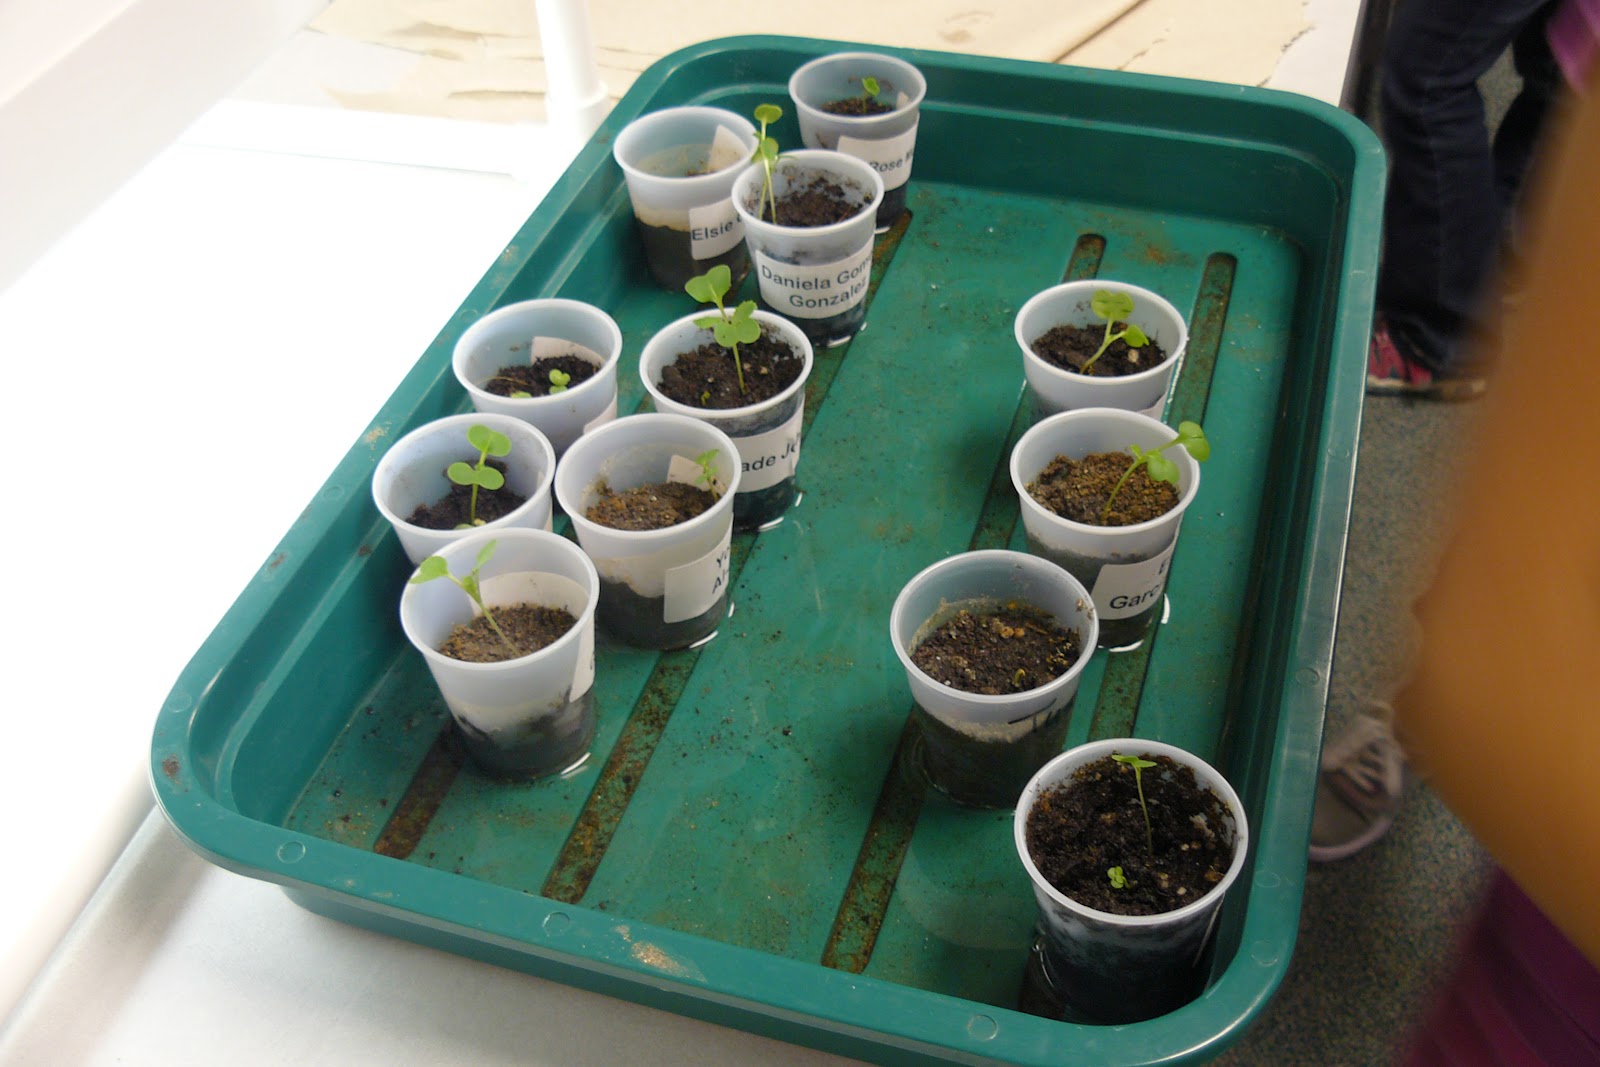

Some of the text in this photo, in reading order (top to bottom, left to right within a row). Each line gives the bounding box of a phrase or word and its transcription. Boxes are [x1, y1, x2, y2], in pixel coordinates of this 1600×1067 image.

[691, 222, 733, 241] Elsie
[761, 265, 831, 290] Daniela
[742, 456, 776, 472] ade
